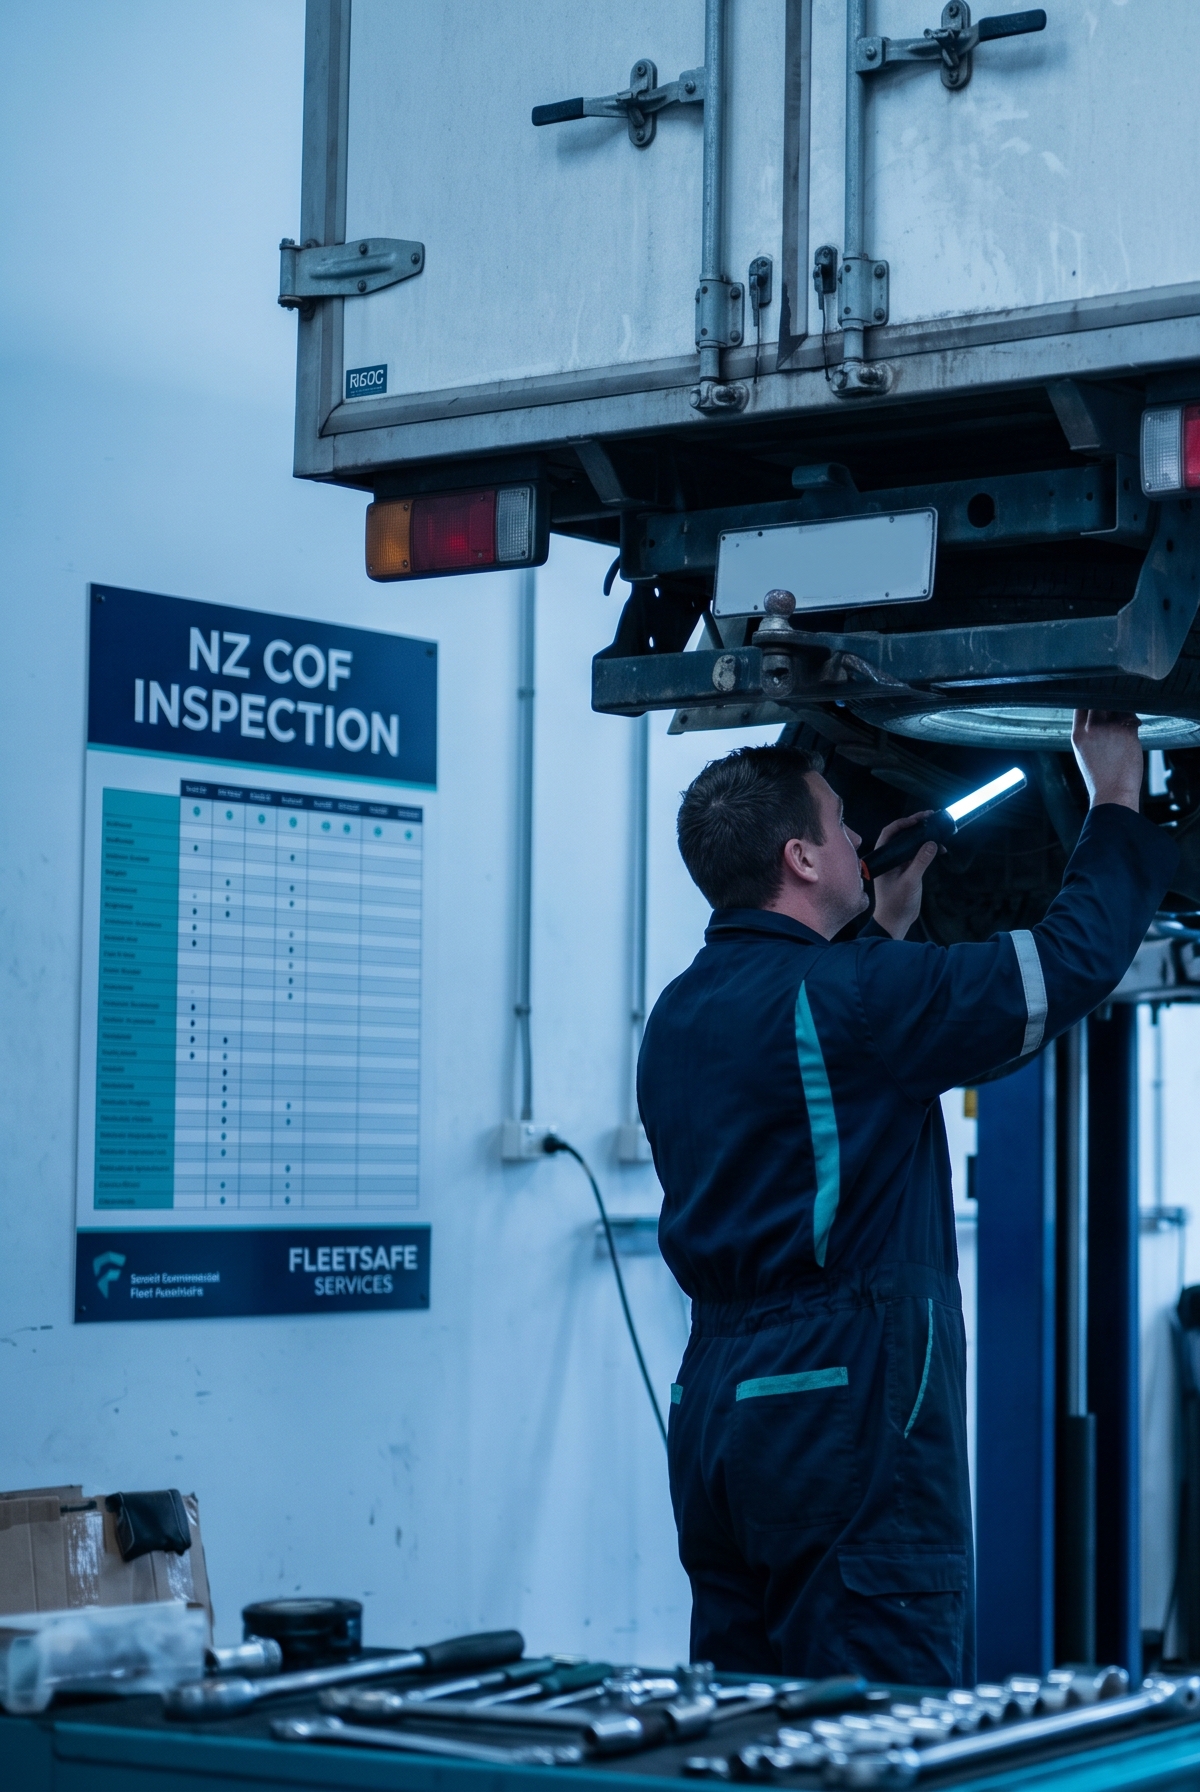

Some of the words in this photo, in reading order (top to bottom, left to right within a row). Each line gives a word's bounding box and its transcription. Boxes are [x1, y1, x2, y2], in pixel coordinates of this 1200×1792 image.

[189, 626, 250, 679] NZ
[263, 639, 353, 691] COF
[134, 678, 399, 757] INSPECTION
[288, 1244, 418, 1273] FLEETSAFE
[314, 1274, 393, 1296] SERVICES
